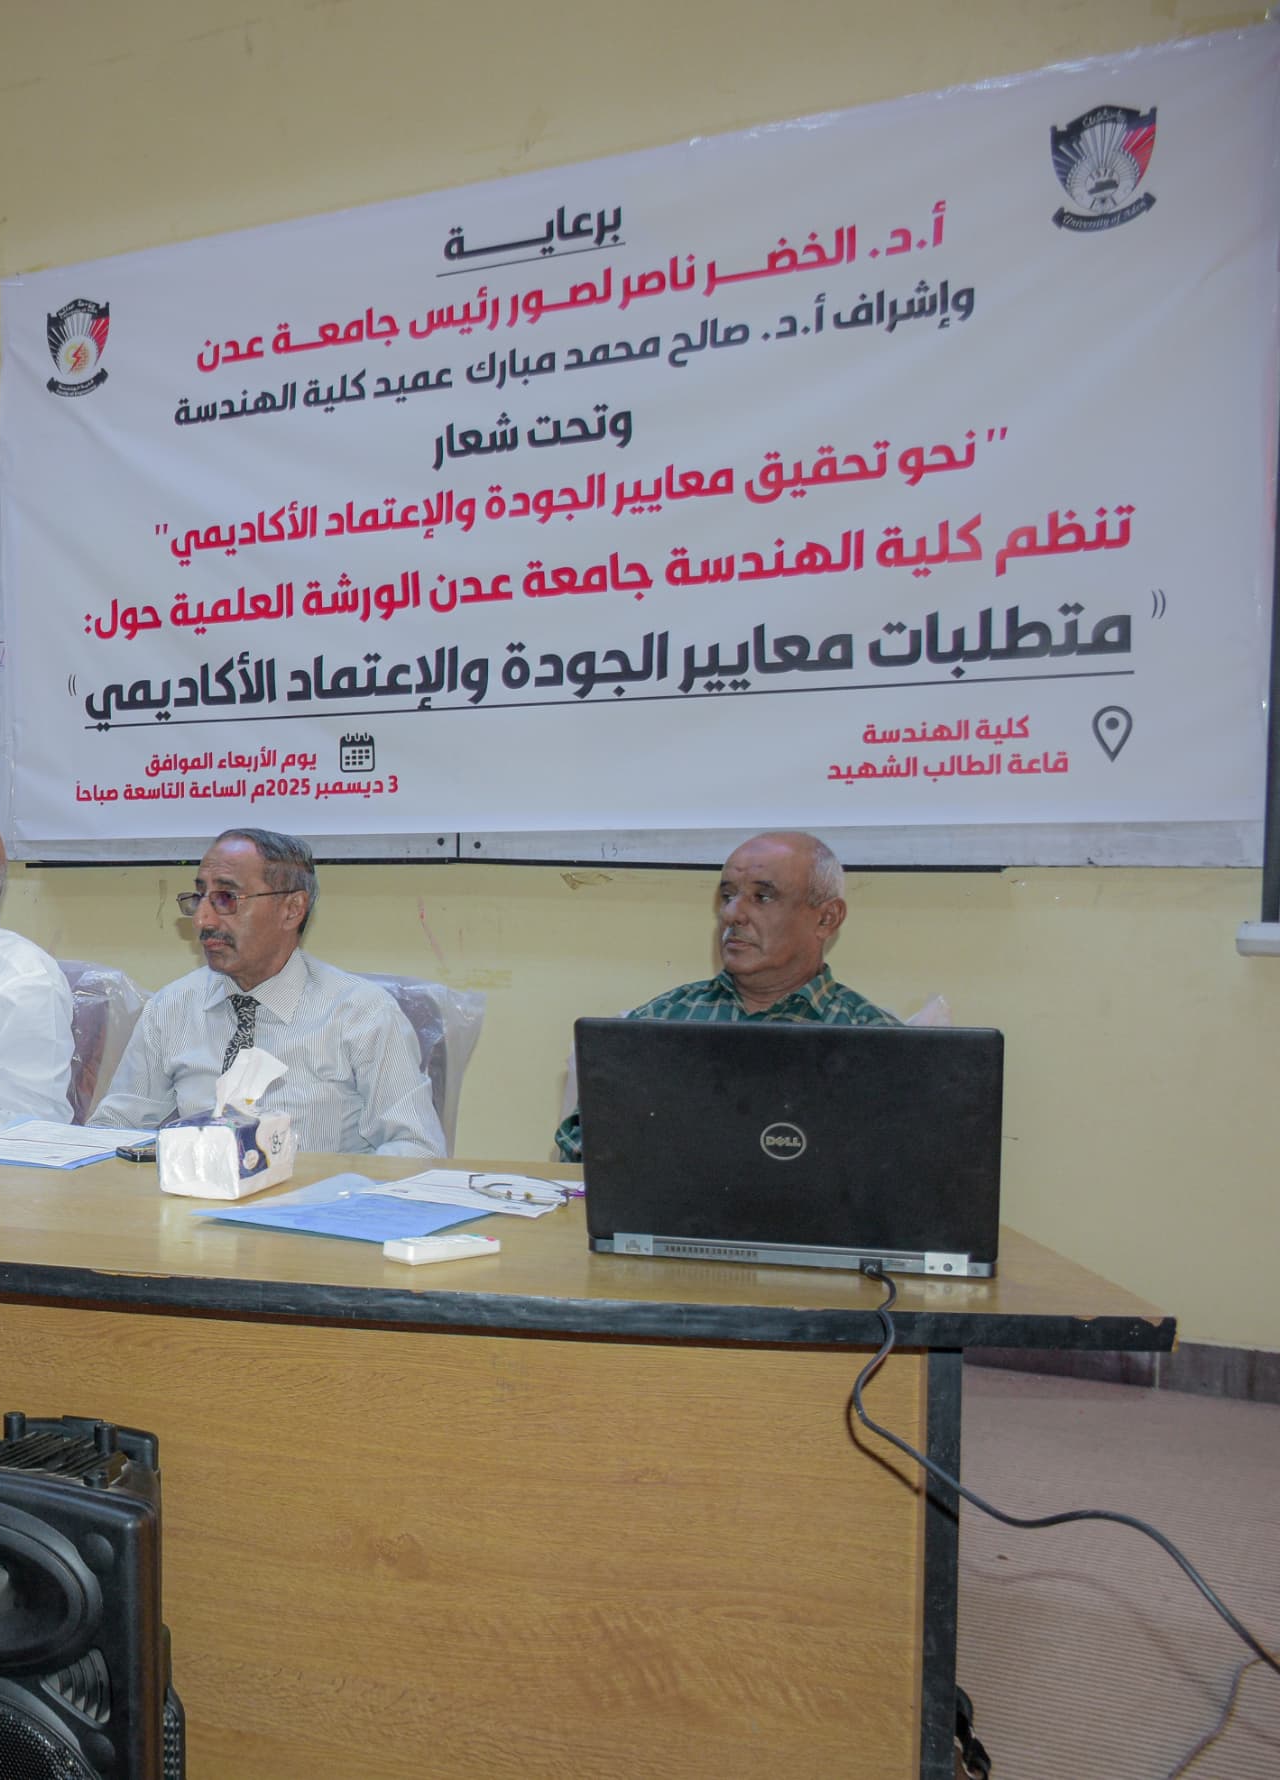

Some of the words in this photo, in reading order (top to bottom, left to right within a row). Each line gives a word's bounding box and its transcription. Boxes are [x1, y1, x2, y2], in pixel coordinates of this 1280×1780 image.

[869, 199, 946, 259] أ.د.
[618, 253, 696, 311] ناصر
[408, 285, 500, 340] رئيس
[761, 292, 826, 341] أ.د.
[832, 279, 975, 334] وإشراف
[196, 335, 265, 373] عدن
[271, 306, 401, 355] جامعة
[563, 335, 661, 371] محمد
[668, 317, 750, 368] صالح
[302, 367, 367, 413] كلية
[373, 367, 453, 404] عميد
[465, 347, 556, 390] مبارك
[174, 380, 297, 426] الهندسة
[526, 403, 633, 449] وتحت
[431, 411, 519, 472] شعار
[611, 463, 734, 517] معايير
[744, 439, 891, 505] تحقيق
[324, 489, 477, 540] والإعتماد
[484, 471, 606, 525] الجودة
[664, 528, 865, 587] الهندسة
[875, 513, 983, 578] كلية
[995, 504, 1136, 577] تنظم
[301, 570, 421, 623] الورشة
[428, 573, 514, 614] عدن
[522, 551, 654, 601] جامعة
[84, 598, 163, 641] حول:
[169, 581, 294, 636] العلمية
[677, 623, 854, 694] معايير
[868, 602, 1132, 679] متطلبات
[286, 644, 489, 712] والإعتماد
[501, 630, 670, 700] الجودة
[862, 719, 970, 746] الهندسة
[975, 715, 1030, 745] كلية
[144, 751, 214, 779] الموافق
[216, 745, 277, 773] الأربعاء
[280, 751, 317, 776] يوم
[827, 753, 918, 785] الشهيد
[923, 753, 1002, 783] الطالب
[1007, 751, 1069, 776] قاعة
[122, 781, 185, 802] التاسعة
[188, 778, 247, 799] الساعة
[314, 779, 384, 801] ديسمبر
[387, 774, 399, 794] 3
[765, 1136, 801, 1147] DELL
